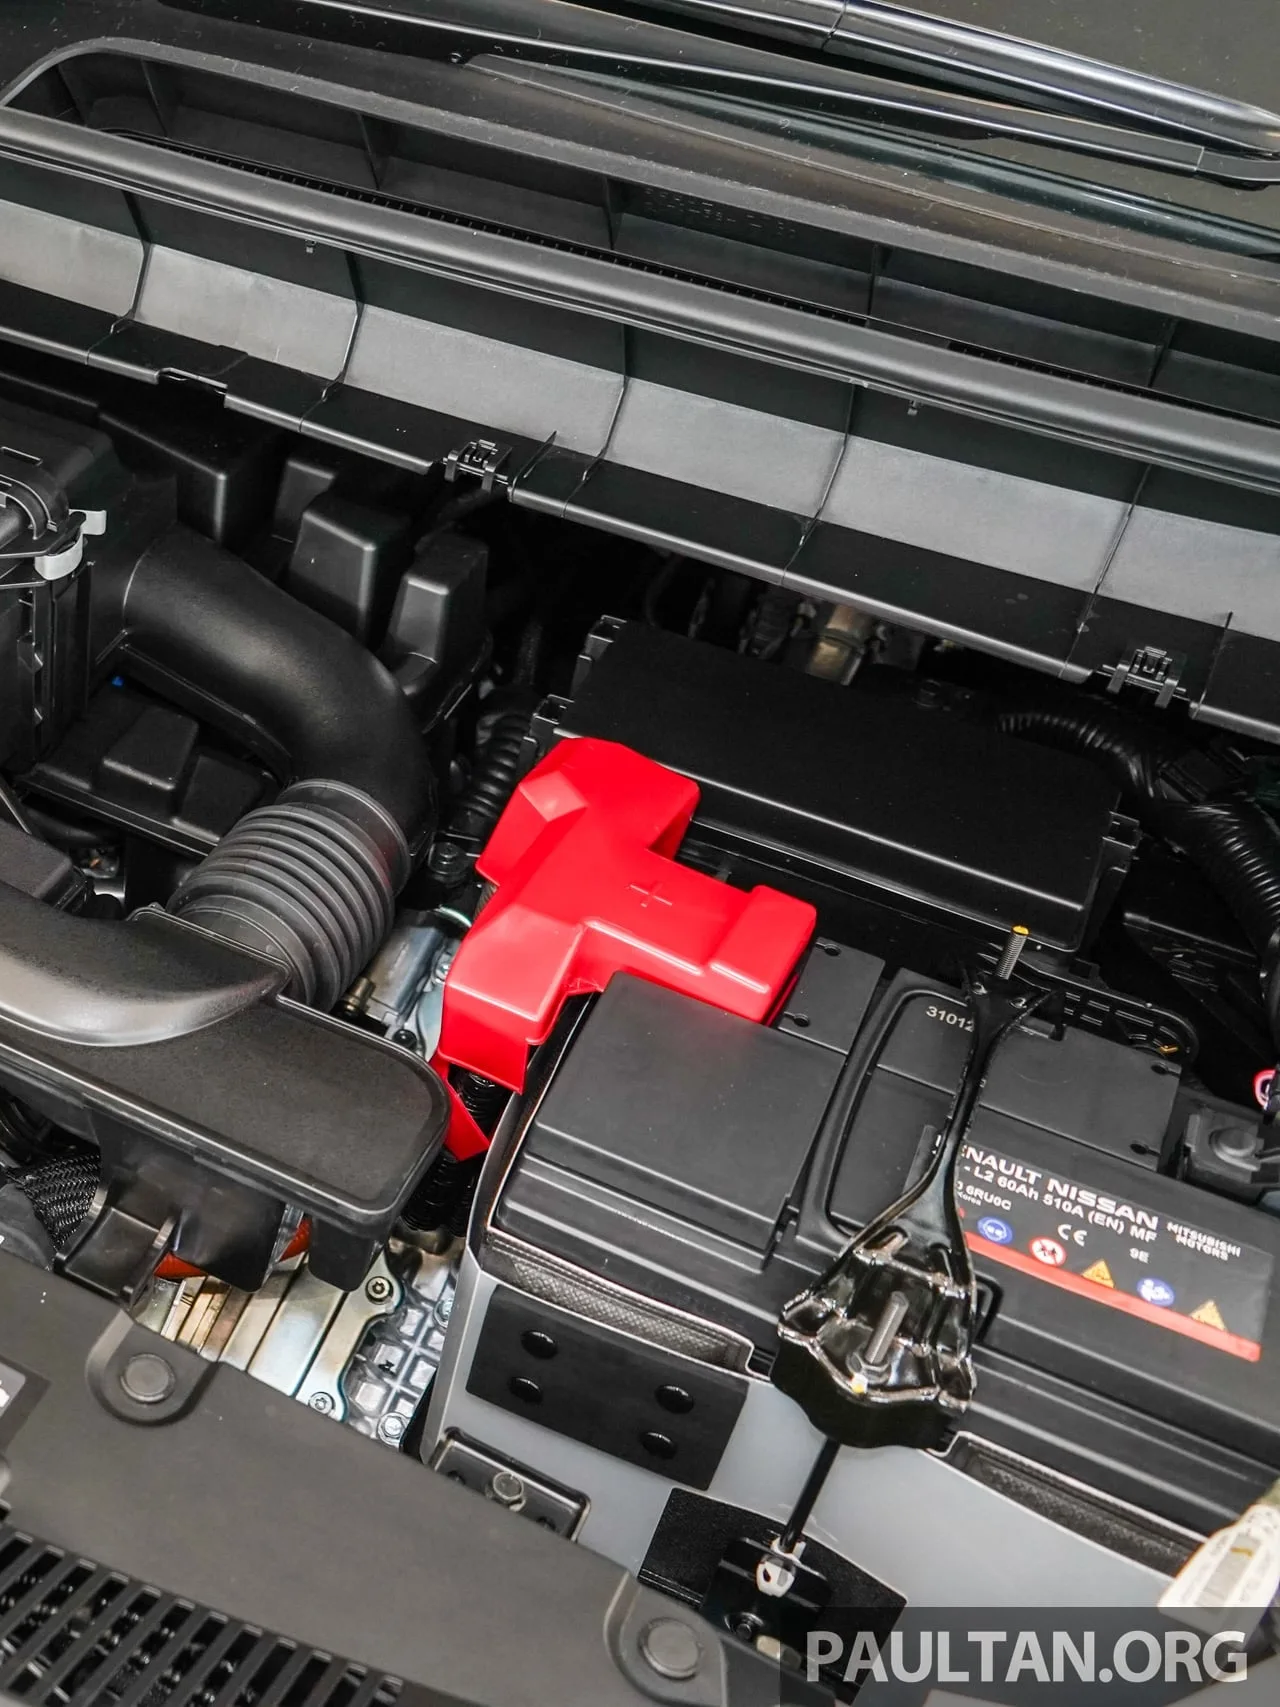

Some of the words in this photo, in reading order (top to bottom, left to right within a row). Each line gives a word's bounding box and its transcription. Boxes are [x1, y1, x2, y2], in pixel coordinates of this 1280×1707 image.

[974, 1166, 995, 1183] L2
[997, 1176, 1039, 1201] 60Ah
[1043, 1193, 1085, 1219] 510A
[1088, 1210, 1125, 1235] (EN)
[1129, 1224, 1159, 1243] MF
[1047, 1177, 1160, 1232] NISSAN
[1166, 1221, 1242, 1258] MITSUBISHI
[1175, 1234, 1229, 1262] MOTORS
